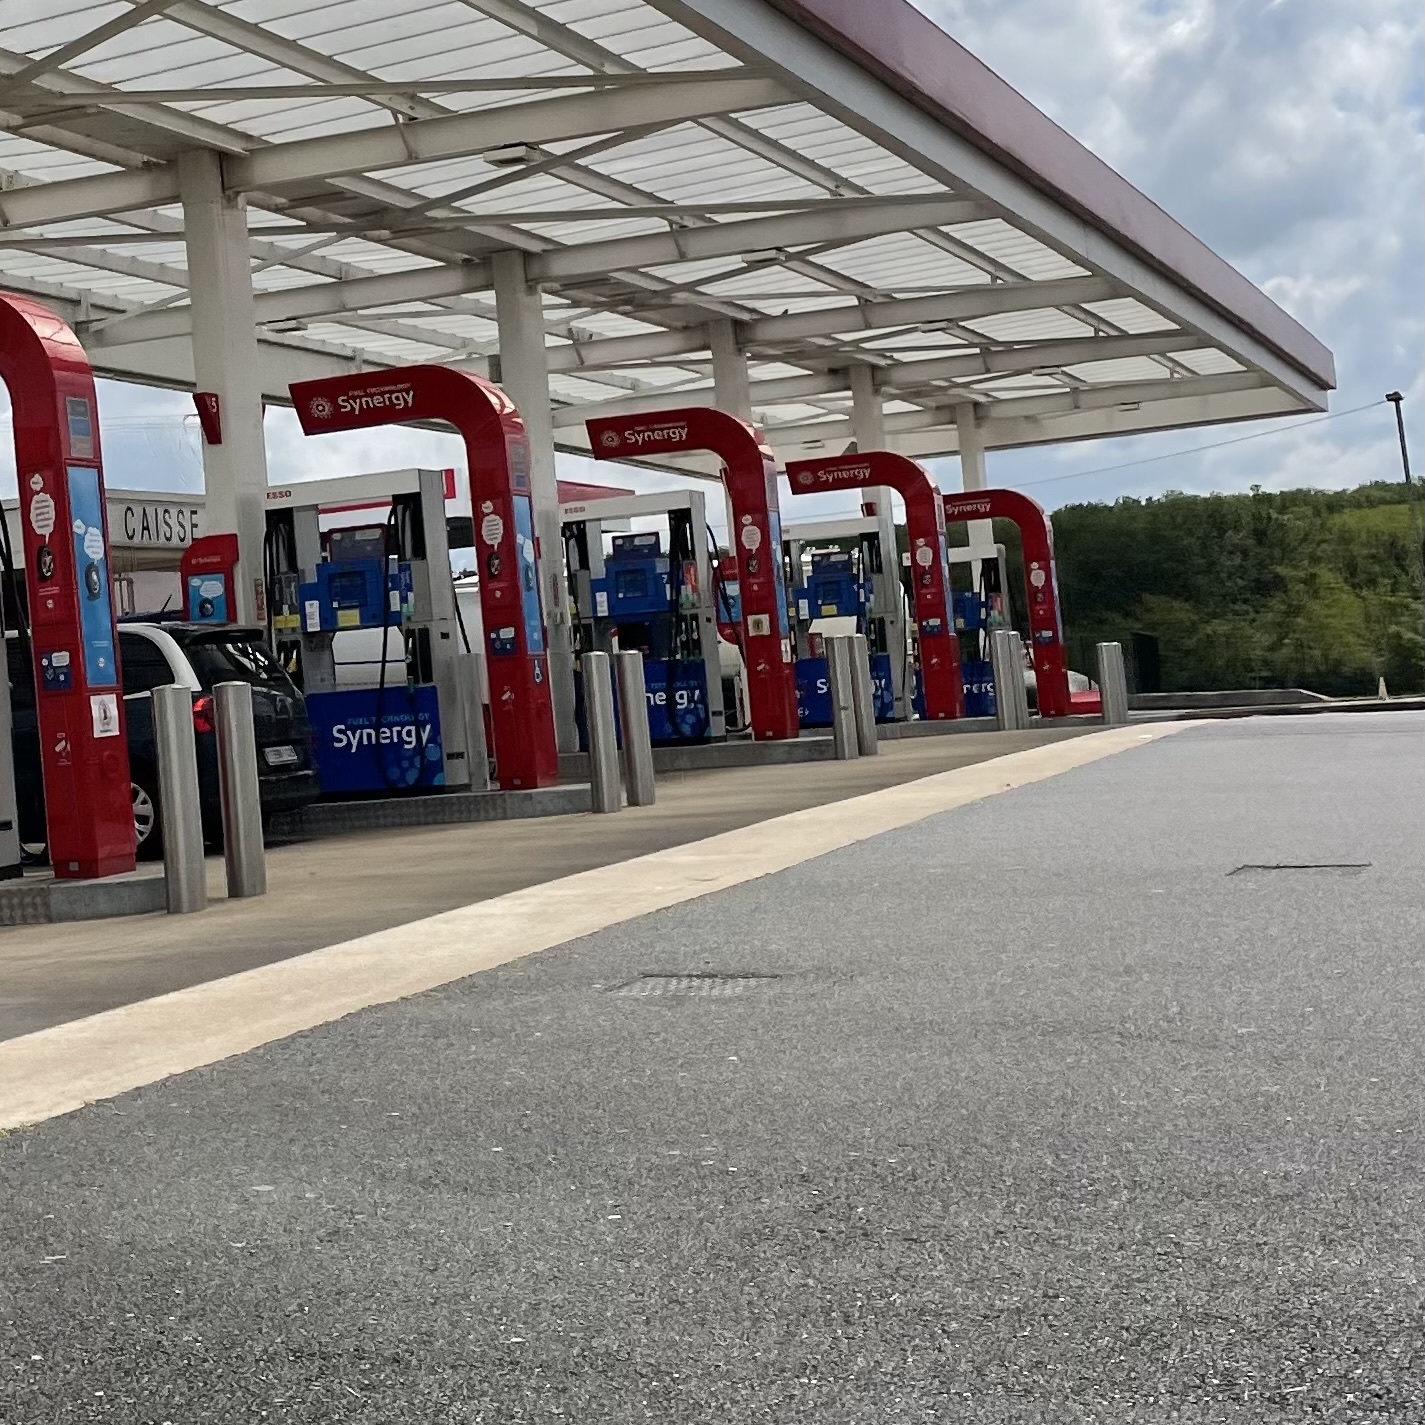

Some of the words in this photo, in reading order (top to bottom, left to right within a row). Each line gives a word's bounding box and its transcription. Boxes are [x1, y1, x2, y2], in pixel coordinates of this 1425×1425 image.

[210, 397, 218, 413] 5
[337, 390, 414, 415] Synergy
[624, 426, 688, 445] Synergy
[816, 466, 871, 483] Synergy
[266, 490, 292, 500] ESSO
[123, 506, 199, 543] CAISSE
[332, 722, 432, 753] Synergy
